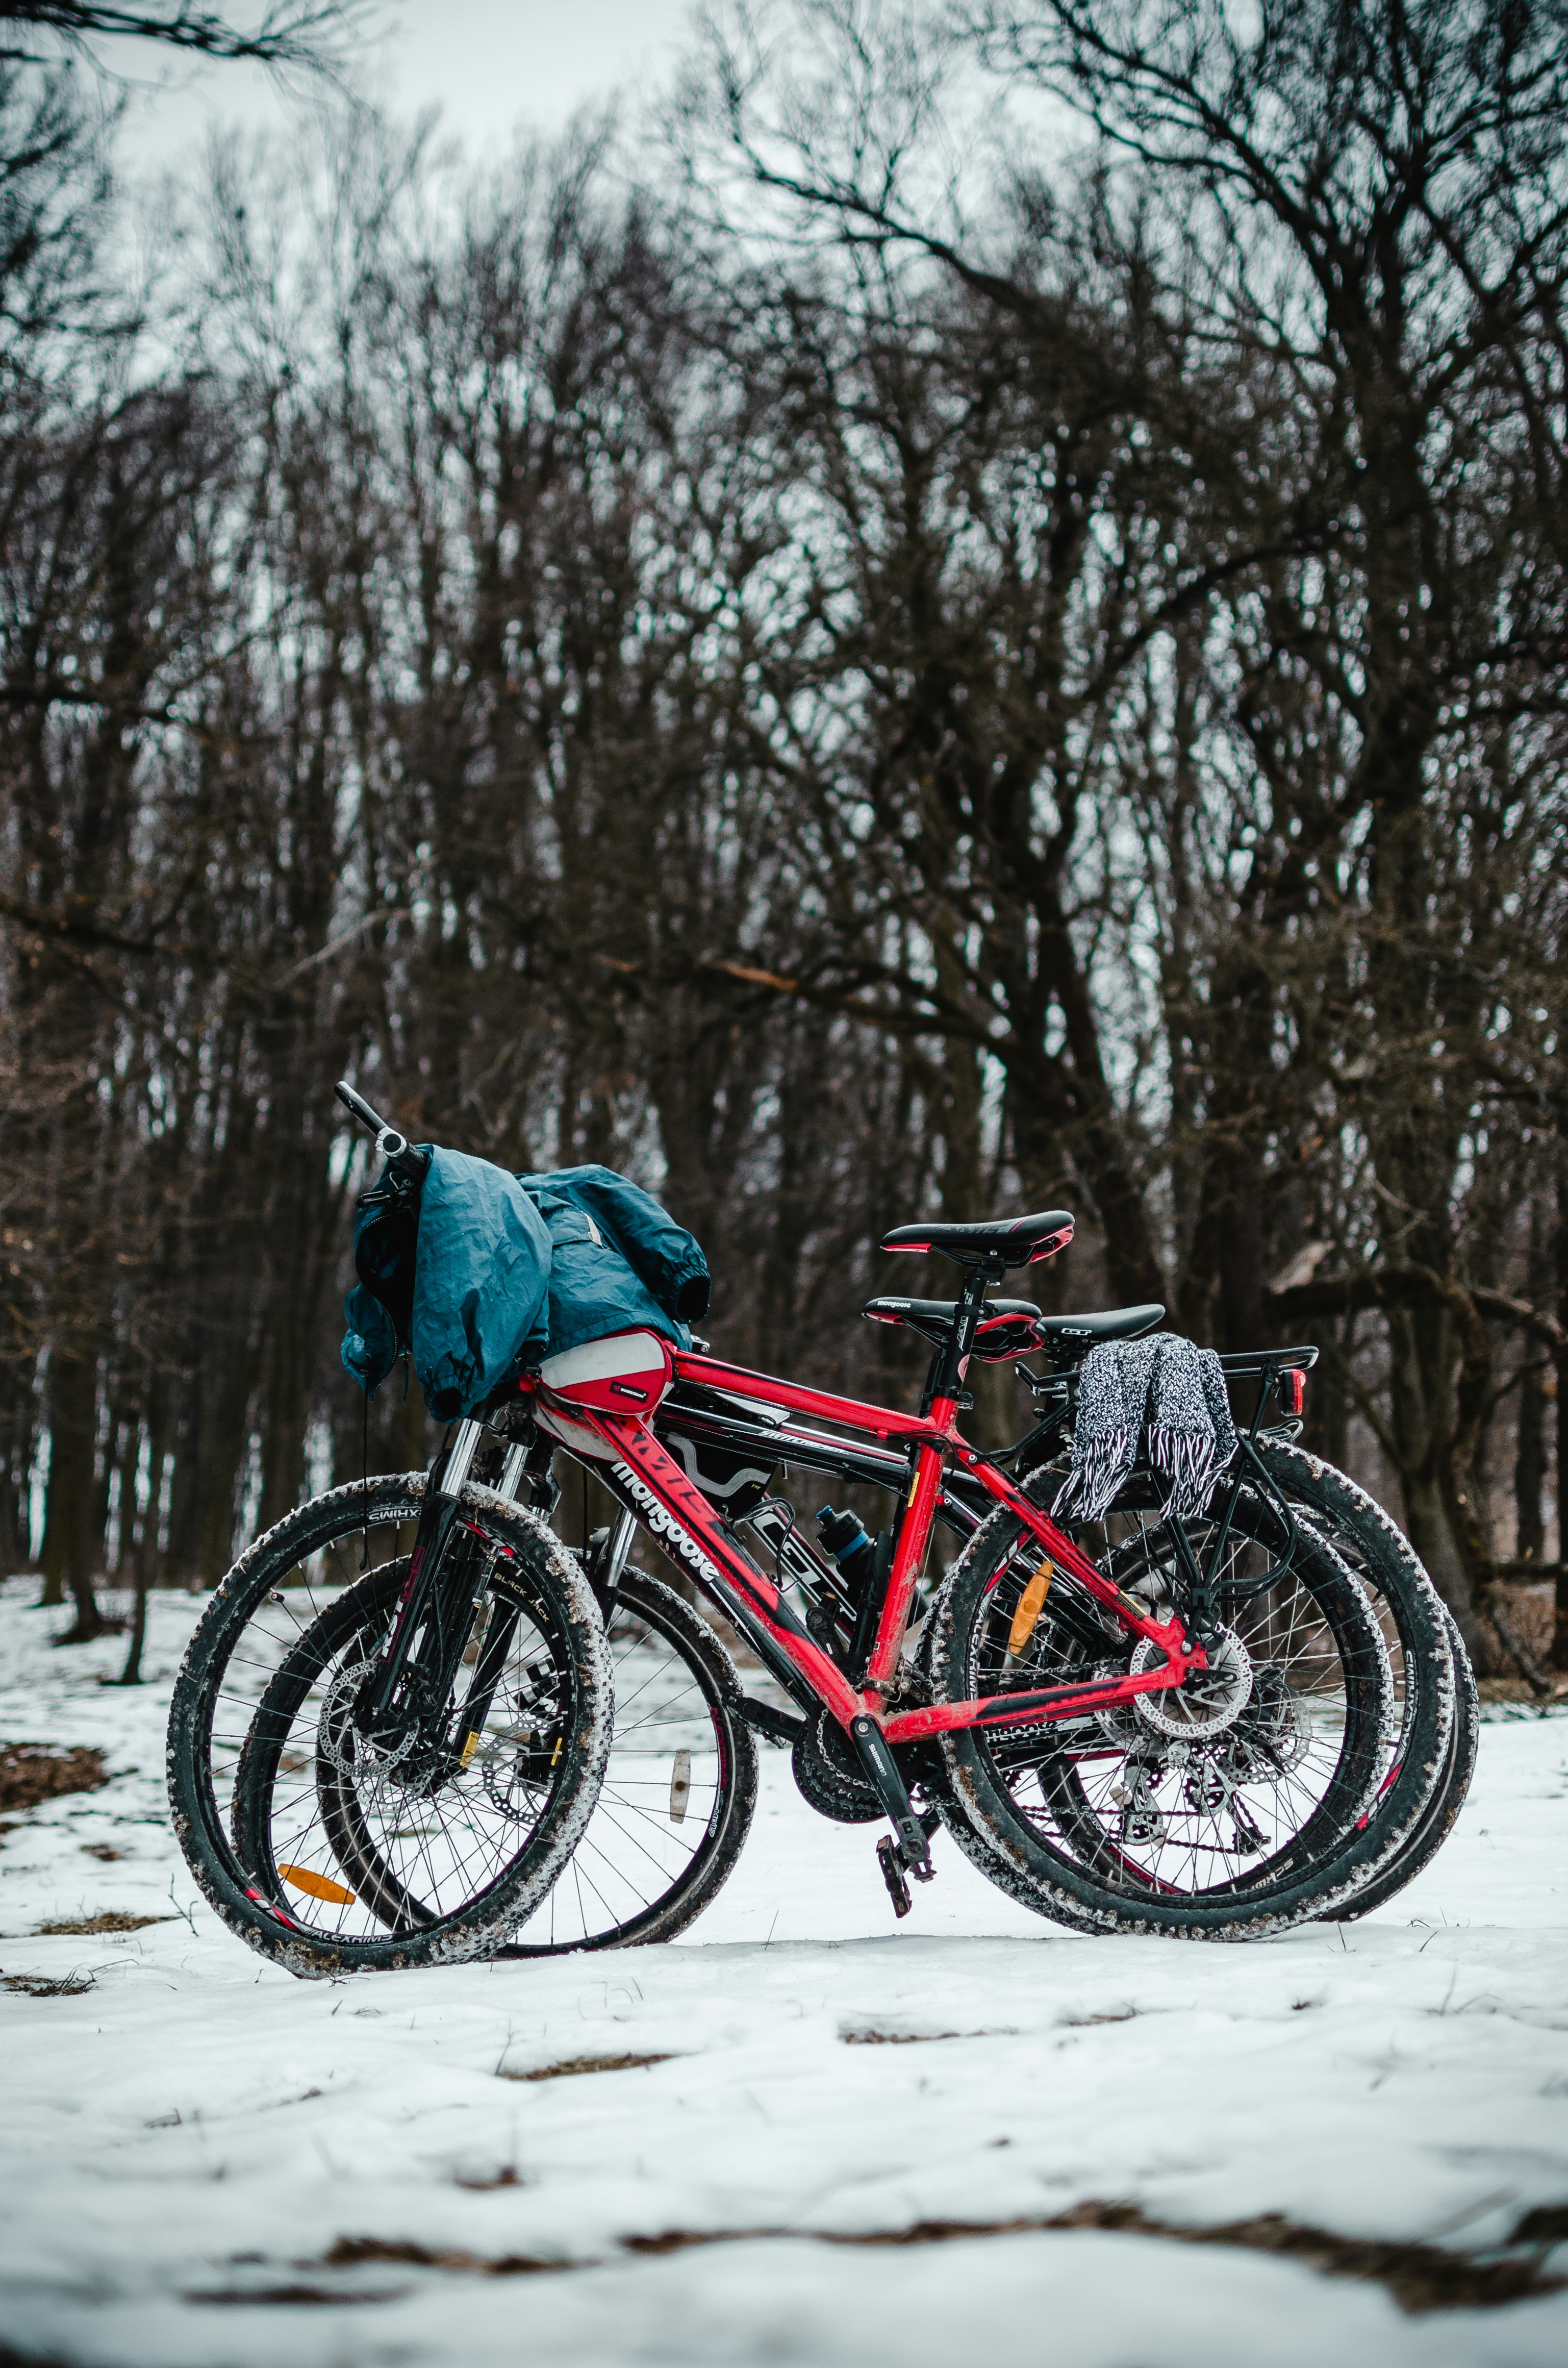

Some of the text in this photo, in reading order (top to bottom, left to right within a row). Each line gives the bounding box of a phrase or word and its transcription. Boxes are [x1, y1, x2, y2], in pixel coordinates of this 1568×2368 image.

[956, 1292, 974, 1351] JAMS
[758, 1431, 847, 1454] SWITCHBACK
[369, 1509, 422, 1521] XRIMS
[611, 1462, 720, 1581] mongoose
[753, 1512, 857, 1622] GT
[494, 1573, 549, 1623] BLACK JACK
[382, 1595, 403, 1657] RST
[970, 1608, 984, 1701] ALEXRIMS
[1402, 1650, 1415, 1748] ALEXRIMS
[869, 1743, 887, 1776] SHIMANO
[708, 1808, 719, 1837] MD17
[311, 1929, 393, 1943] ALEXRIMS
